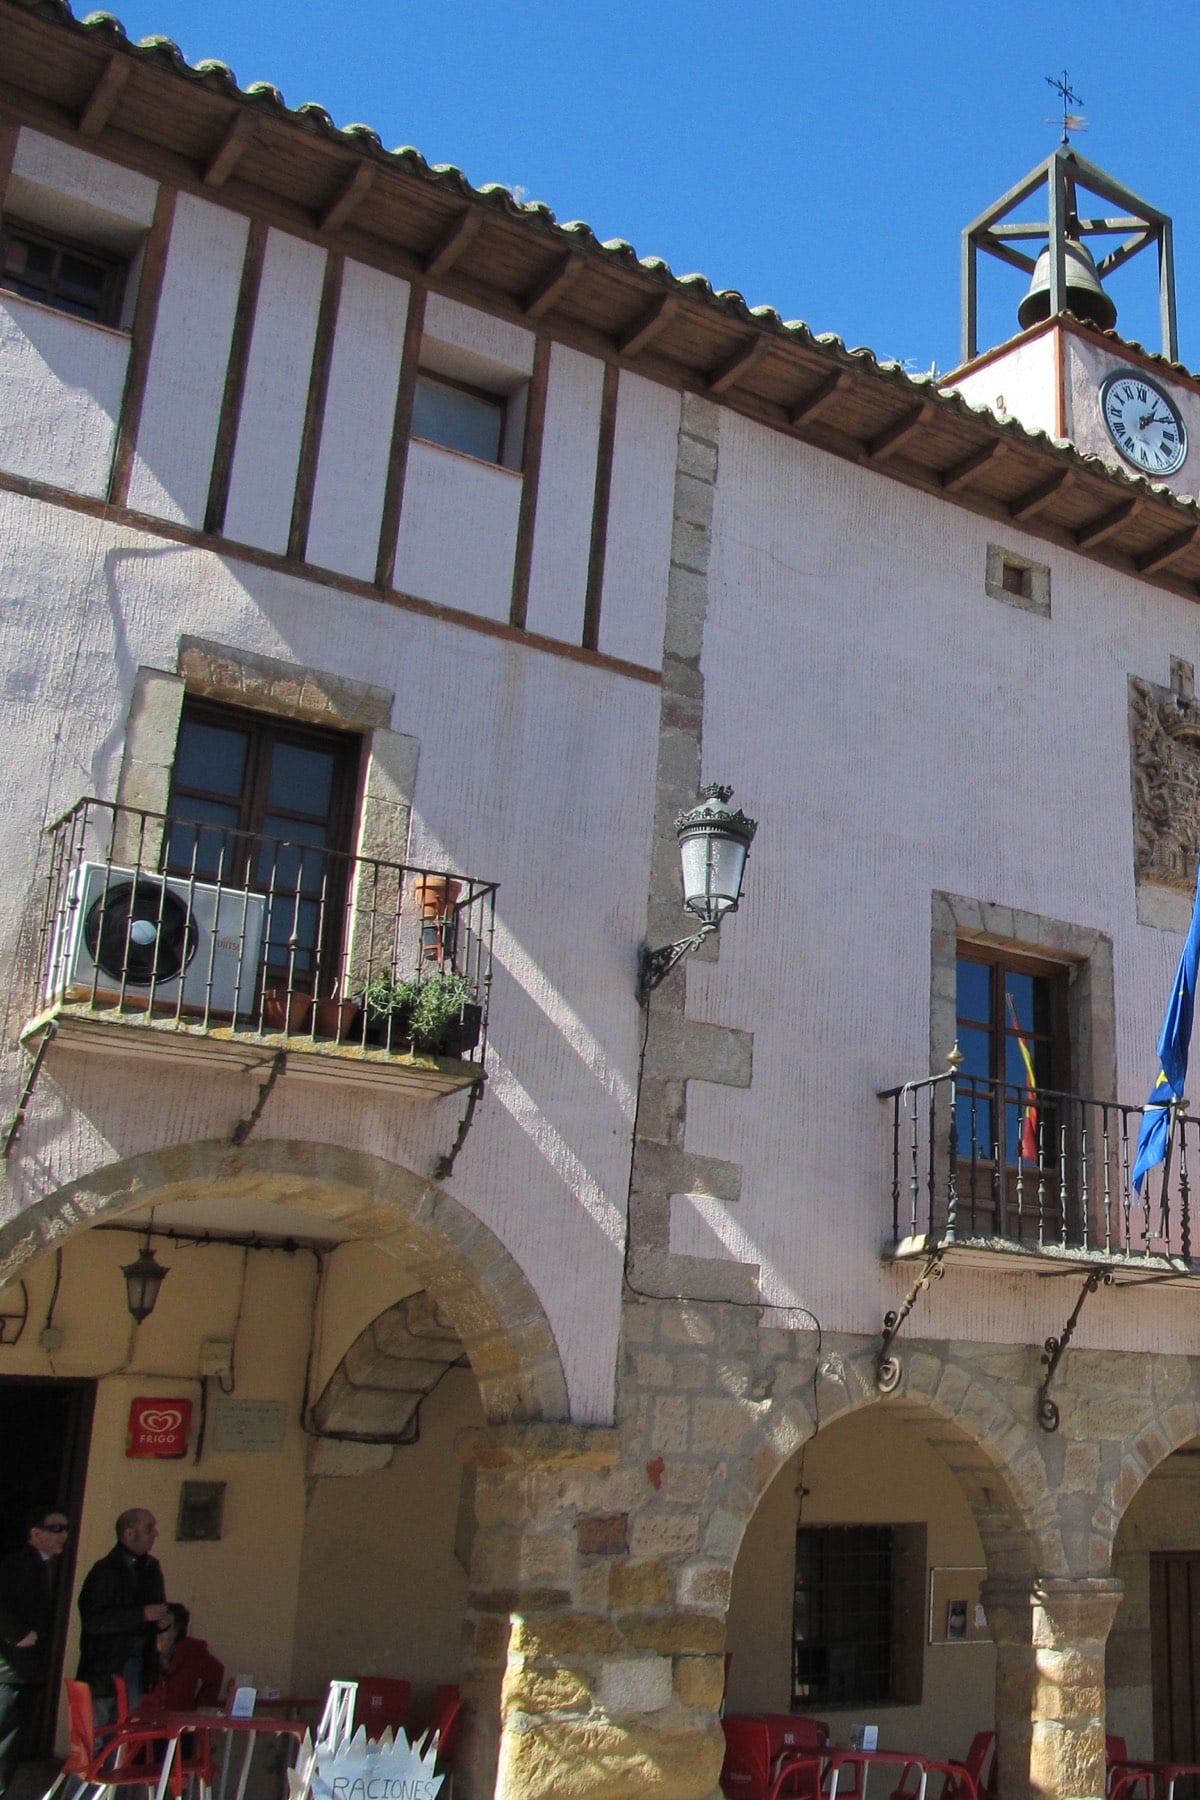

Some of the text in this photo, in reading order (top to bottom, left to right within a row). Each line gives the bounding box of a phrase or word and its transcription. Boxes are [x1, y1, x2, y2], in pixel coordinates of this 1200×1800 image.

[1114, 392, 1125, 406] X
[139, 1434, 176, 1444] FRIGO
[332, 1776, 435, 1800] RACIONES
